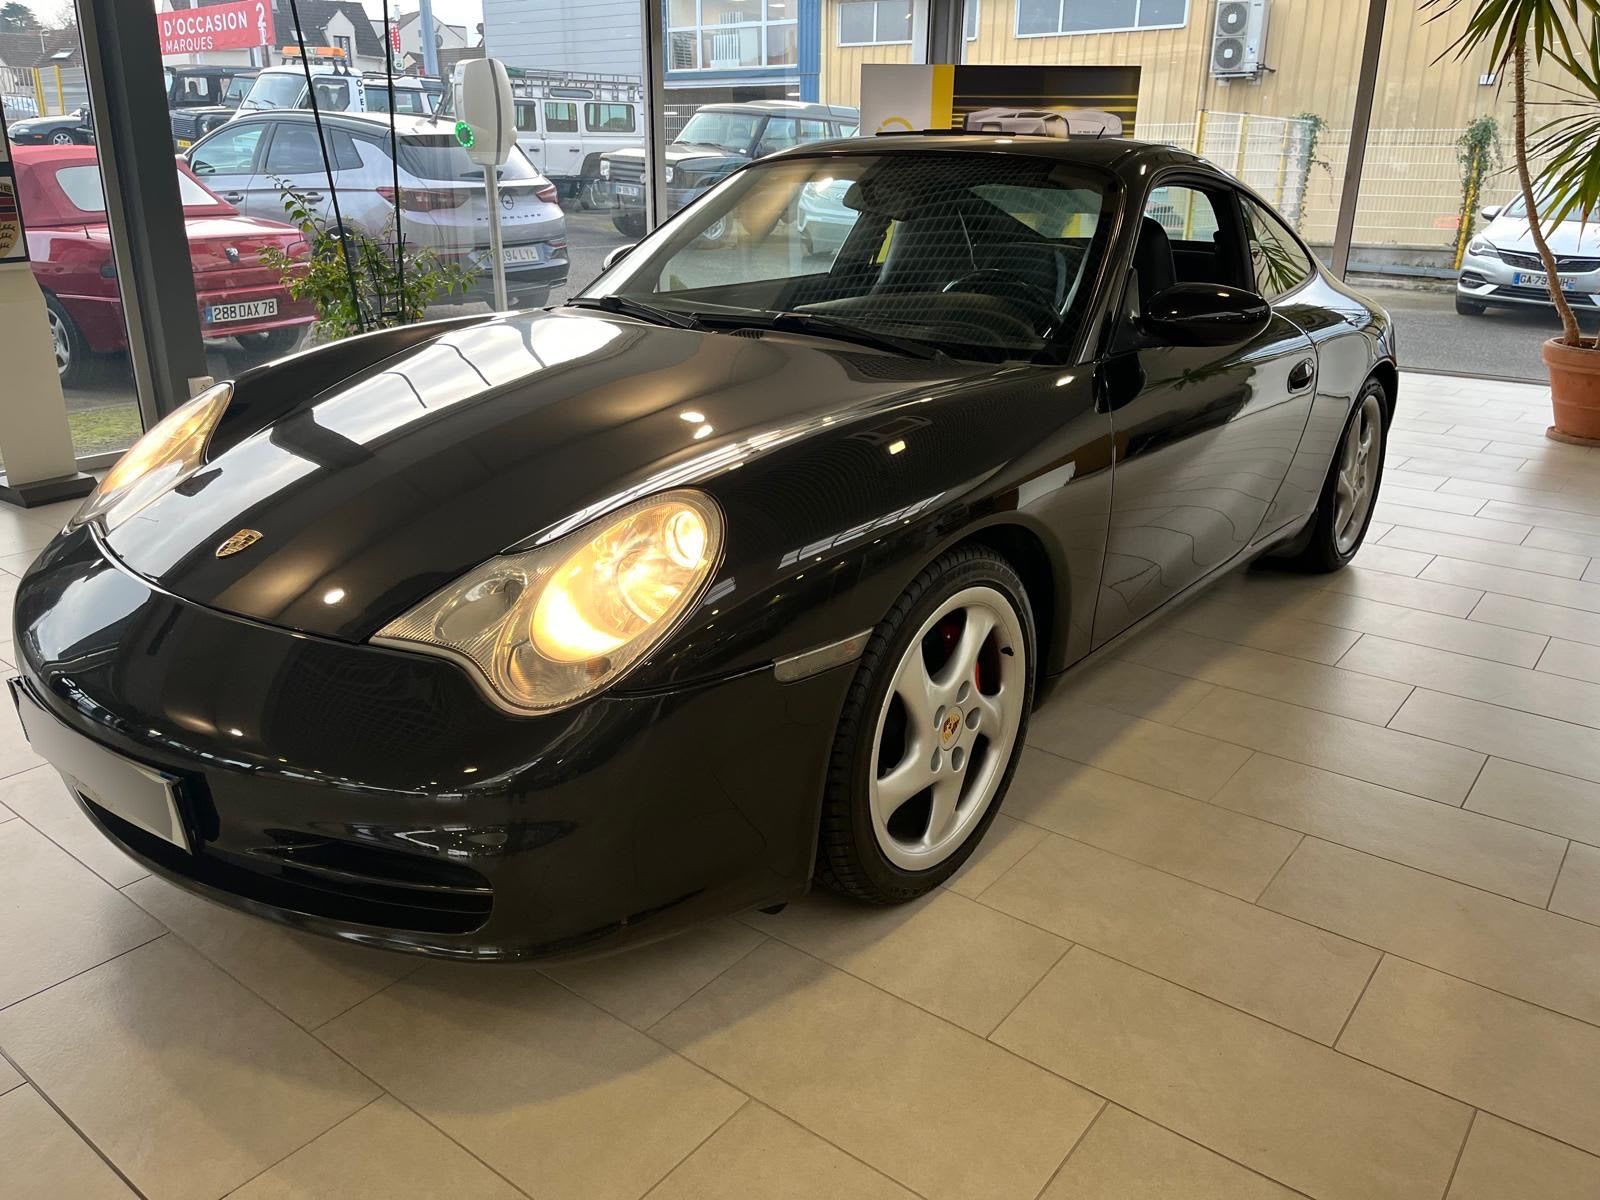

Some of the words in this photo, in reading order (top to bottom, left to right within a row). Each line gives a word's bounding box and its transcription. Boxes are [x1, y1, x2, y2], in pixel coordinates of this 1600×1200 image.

[164, 10, 248, 37] D'OCCASION
[165, 35, 213, 53] MARQUES
[214, 305, 237, 321] 288
[238, 302, 260, 318] DAX
[262, 301, 275, 314] 78
